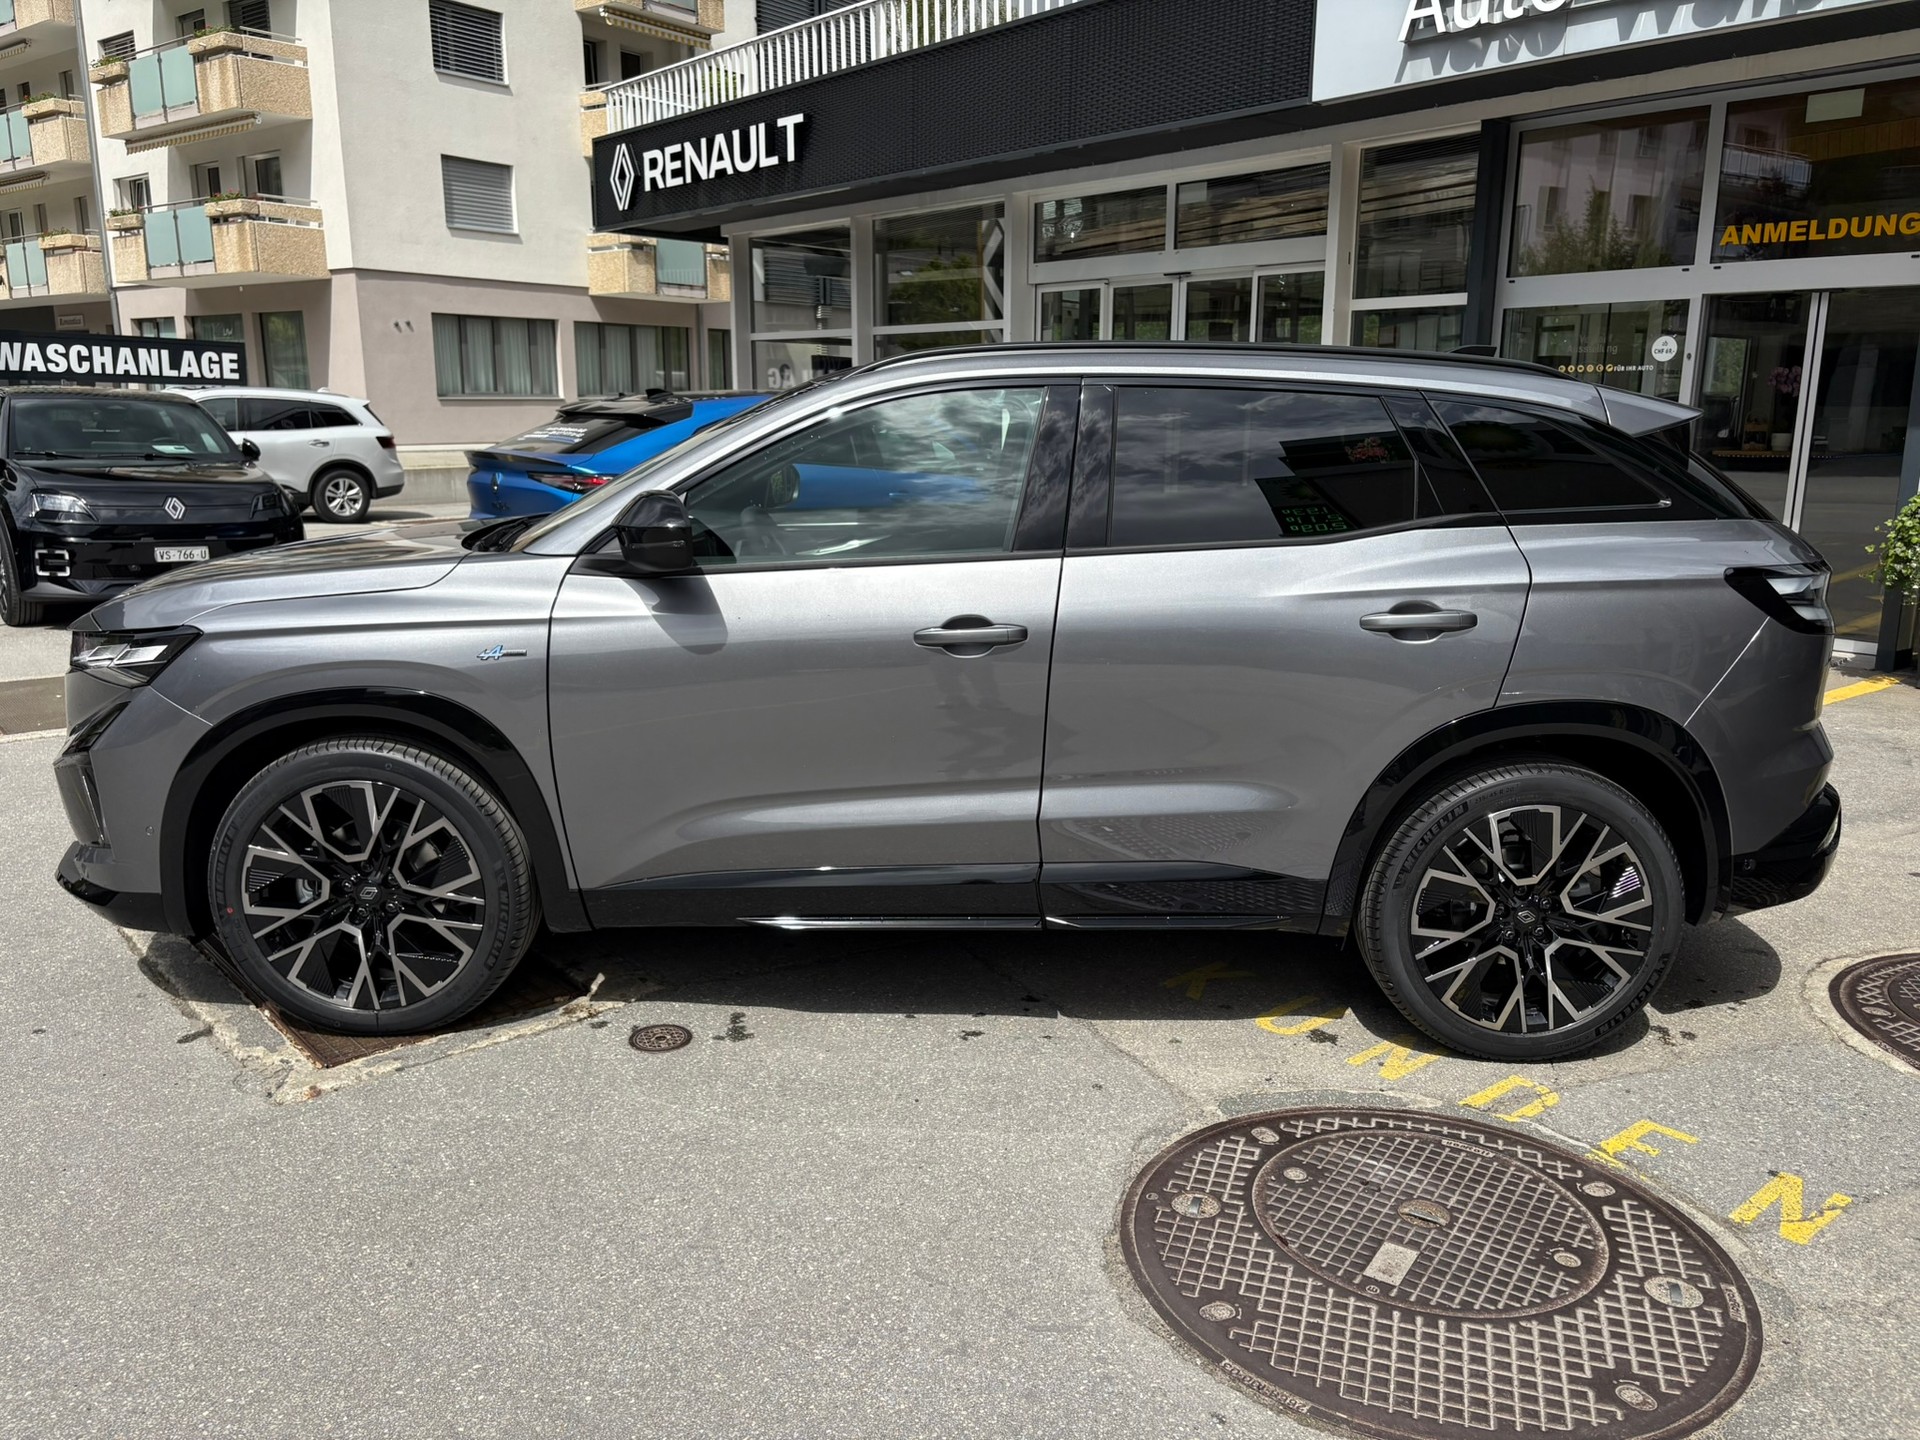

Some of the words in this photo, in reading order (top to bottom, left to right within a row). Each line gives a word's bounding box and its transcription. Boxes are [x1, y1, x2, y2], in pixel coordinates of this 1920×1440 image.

[643, 113, 804, 193] RENAULT
[1719, 211, 1920, 246] ANMELDUNG
[0, 341, 240, 380] WASCHANLAGE
[1637, 364, 1654, 372] AUTO
[1403, 803, 1466, 873] MICHELIN
[487, 891, 510, 969] MICHELIN
